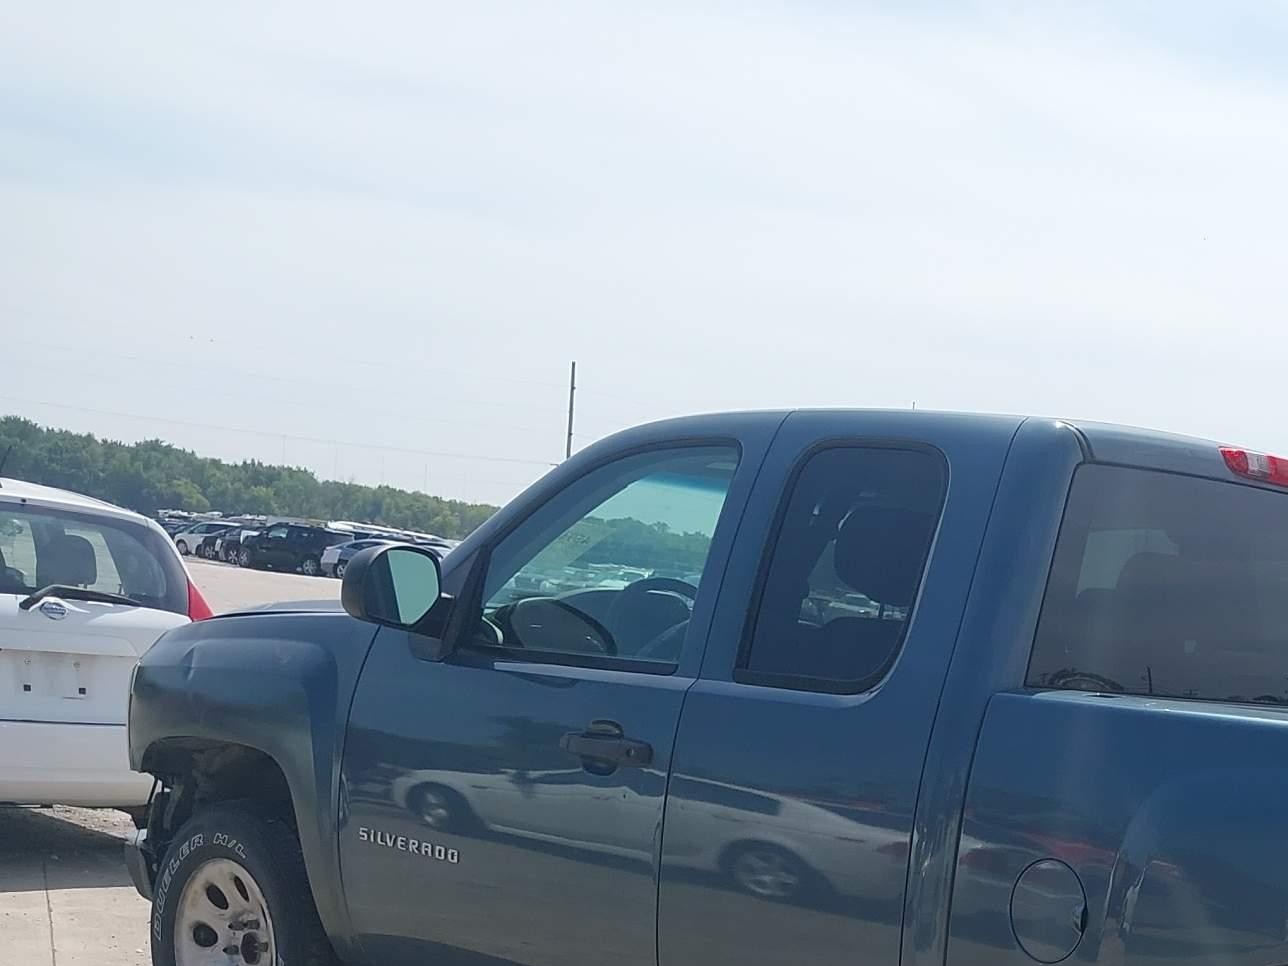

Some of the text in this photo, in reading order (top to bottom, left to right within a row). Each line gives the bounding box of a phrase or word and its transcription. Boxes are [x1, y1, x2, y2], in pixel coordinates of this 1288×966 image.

[359, 827, 459, 863] SILVERADO
[155, 832, 249, 941] DUELER H/L
